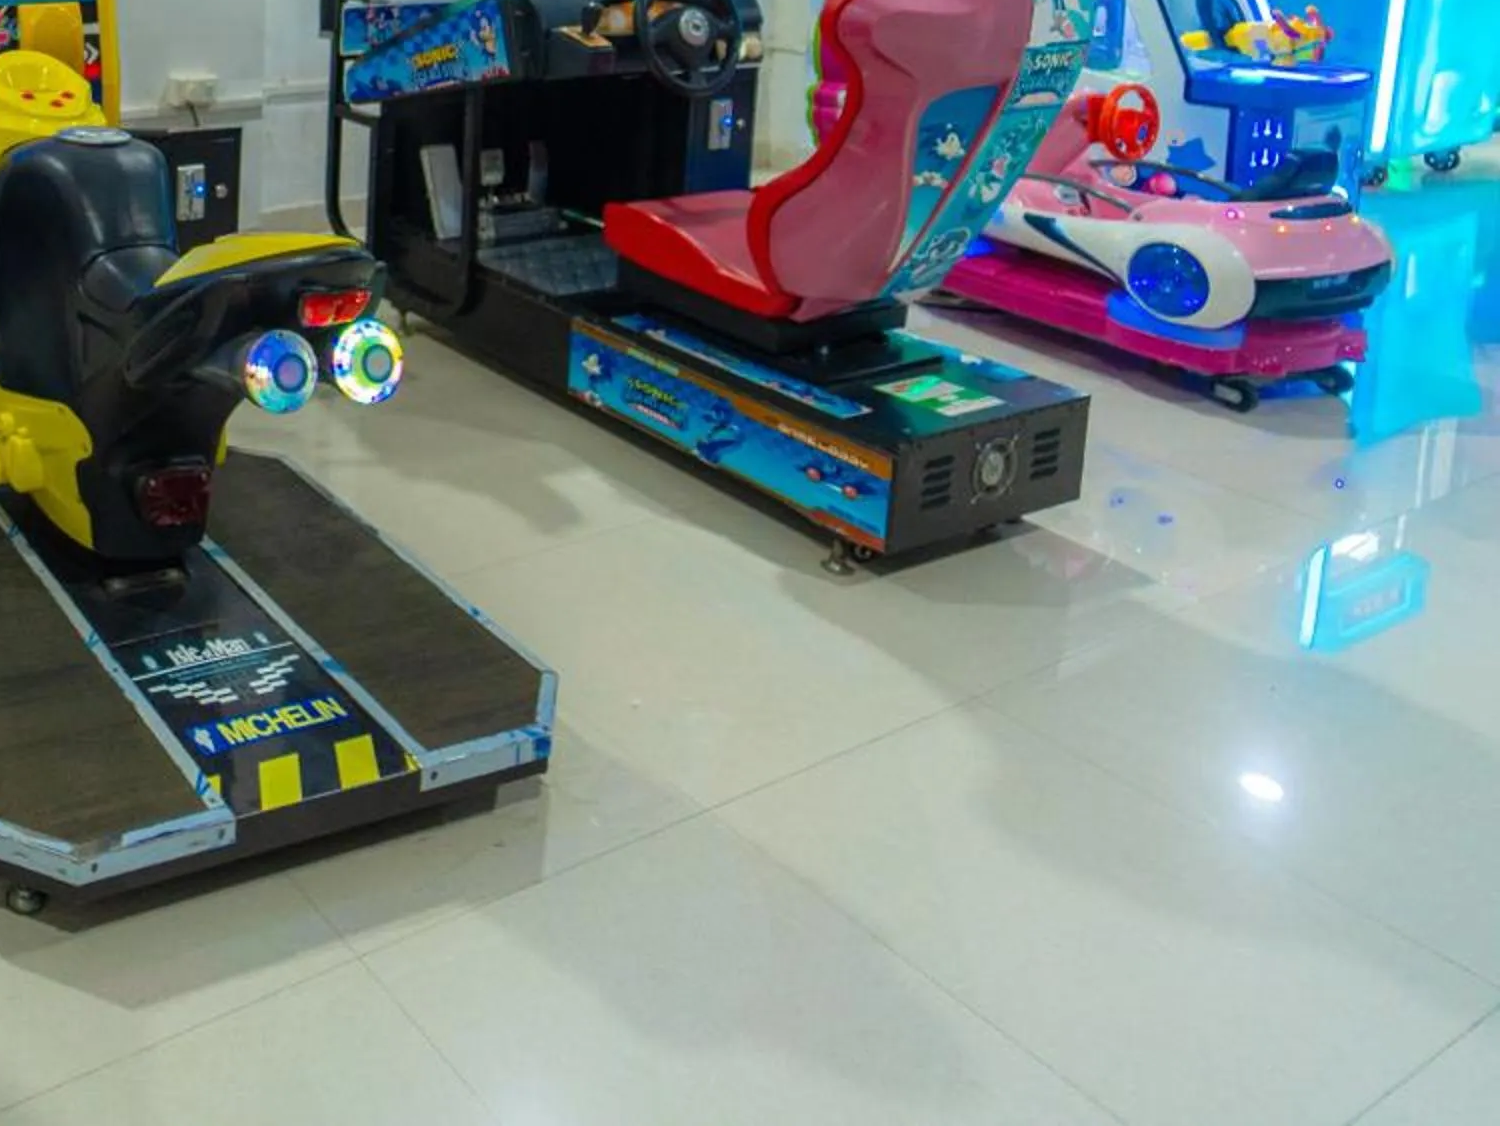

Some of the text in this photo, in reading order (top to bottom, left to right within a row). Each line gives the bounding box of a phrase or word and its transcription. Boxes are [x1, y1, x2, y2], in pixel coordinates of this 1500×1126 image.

[166, 643, 200, 666] Isle
[206, 637, 251, 657] Man
[215, 697, 350, 746] MICHELIN
